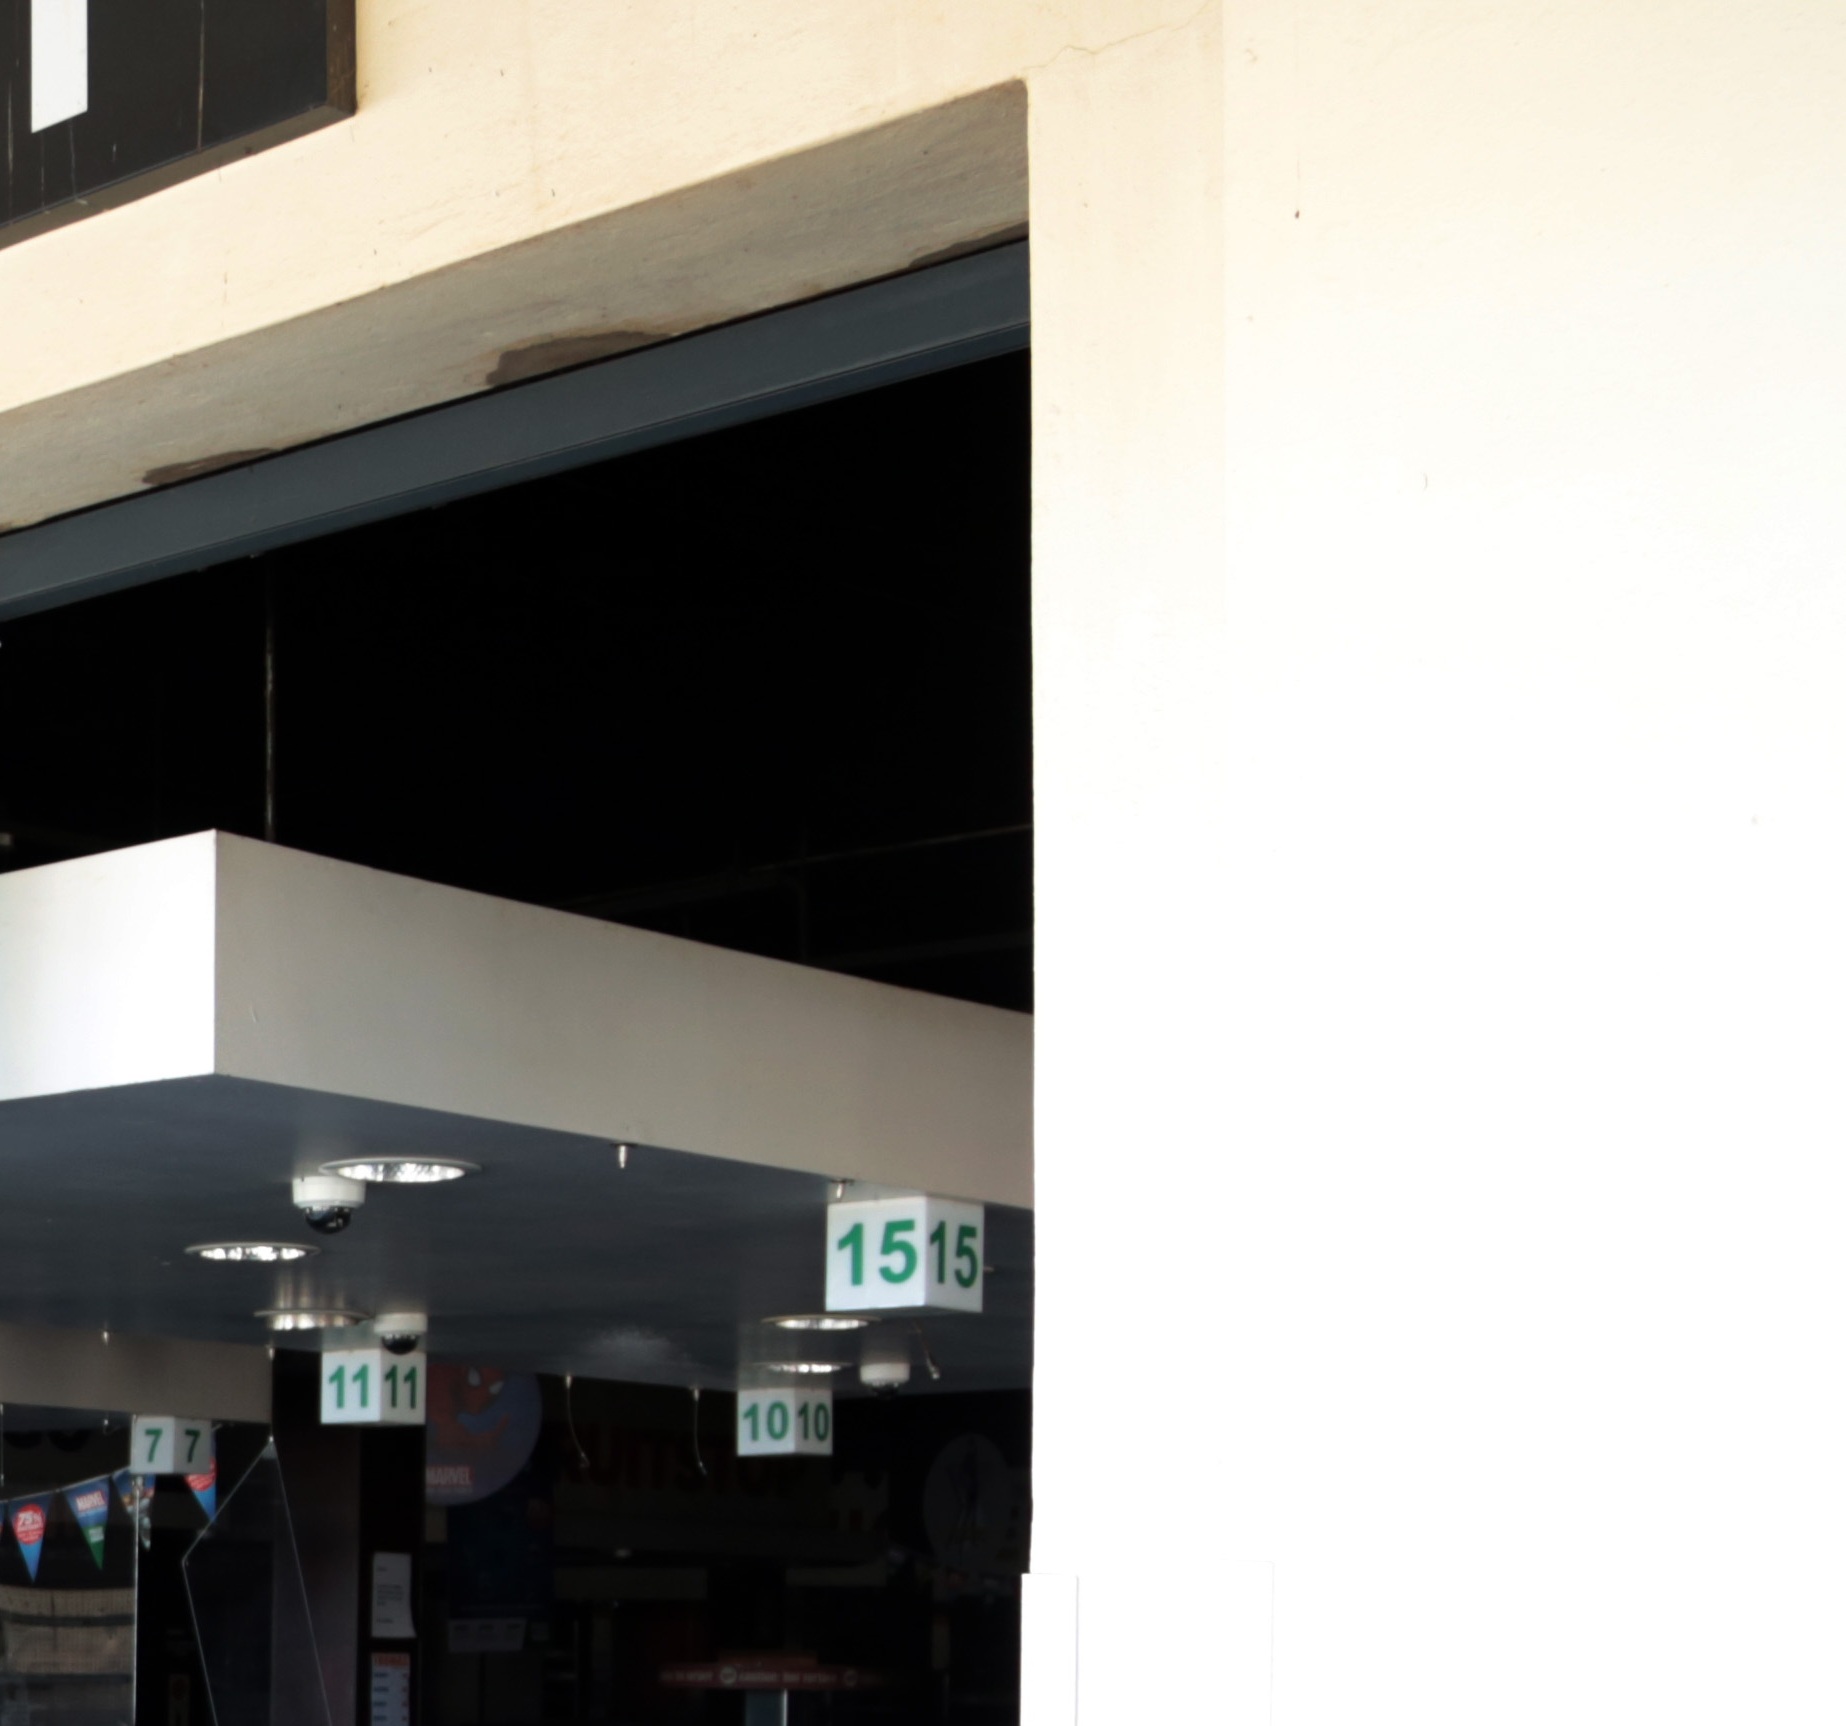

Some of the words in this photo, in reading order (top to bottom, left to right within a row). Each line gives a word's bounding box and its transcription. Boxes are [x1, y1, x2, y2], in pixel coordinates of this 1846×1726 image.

[835, 1218, 919, 1288] 15
[929, 1222, 980, 1289] 15
[325, 1363, 371, 1411] 11
[383, 1367, 420, 1411] 11
[741, 1400, 790, 1443] 10
[795, 1401, 830, 1445] 10
[143, 1427, 164, 1464] 7
[184, 1428, 202, 1465] 7
